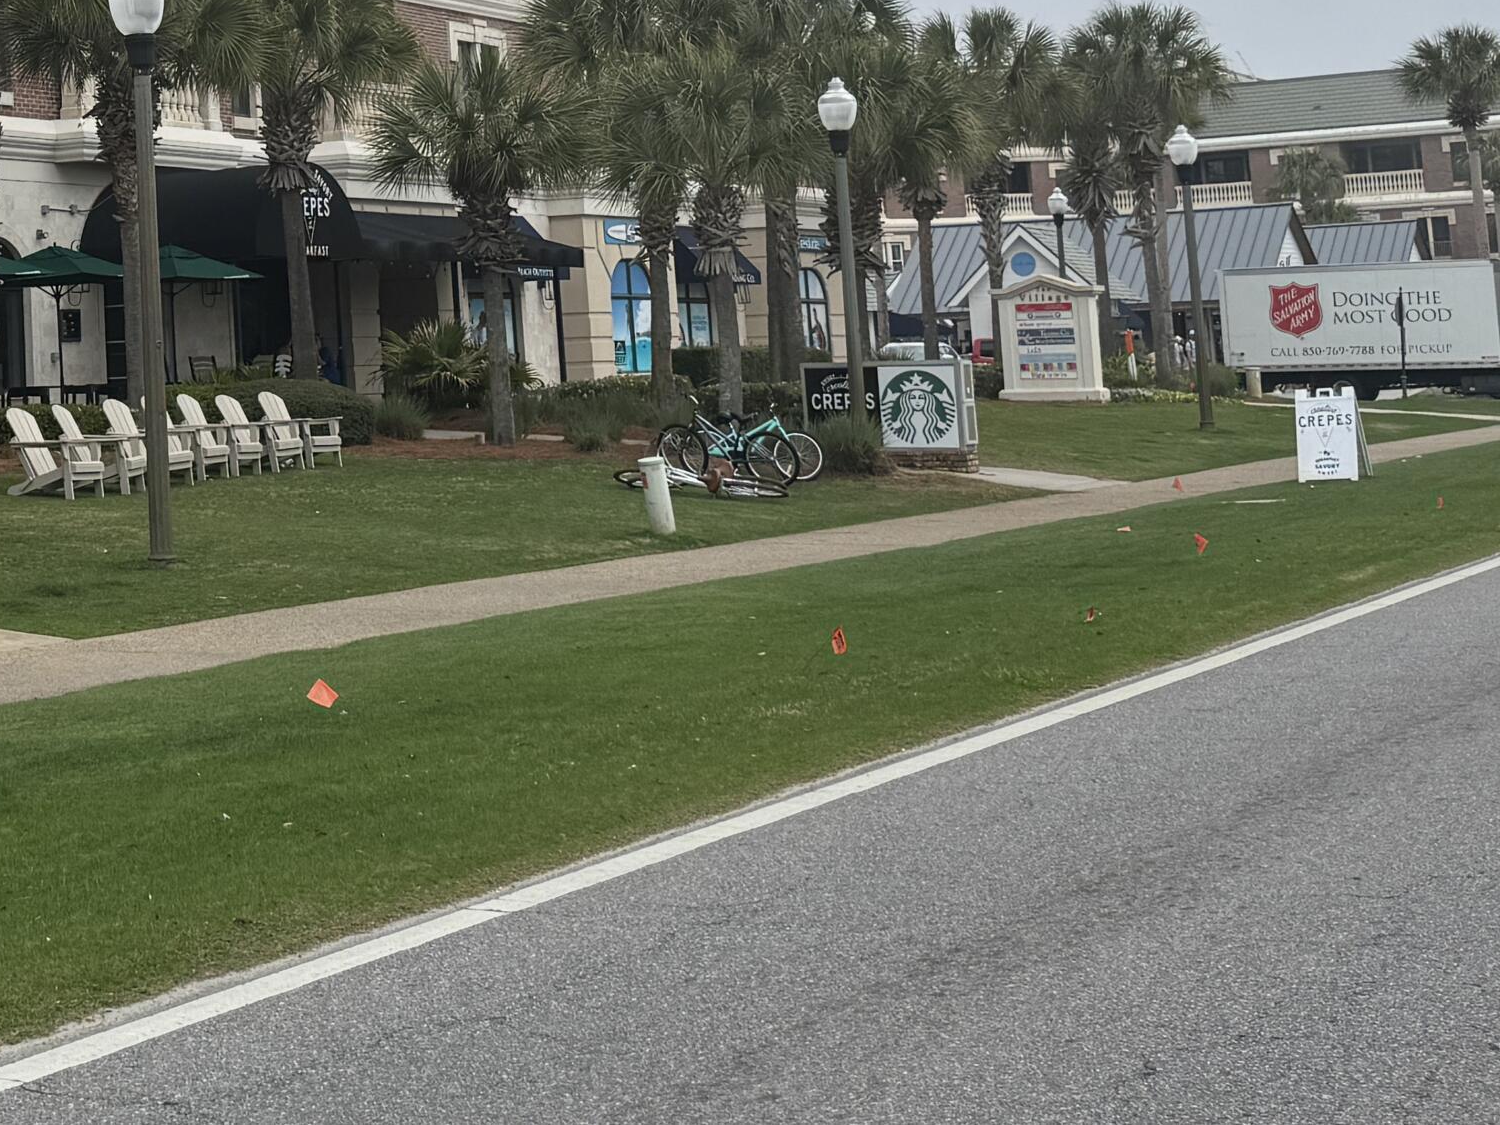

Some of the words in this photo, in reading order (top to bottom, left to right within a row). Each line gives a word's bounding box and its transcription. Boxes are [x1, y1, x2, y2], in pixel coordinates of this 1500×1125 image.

[303, 196, 330, 217] EPES
[1278, 288, 1297, 305] THE
[1402, 290, 1442, 305] THE
[1273, 290, 1315, 324] SALVATION
[1290, 305, 1314, 330] ARMY
[1333, 309, 1386, 324] MOST
[1270, 347, 1299, 357] CALL
[1408, 343, 1453, 355] PICKUP
[811, 392, 875, 410] CREPS
[1298, 413, 1353, 427] CREPES
